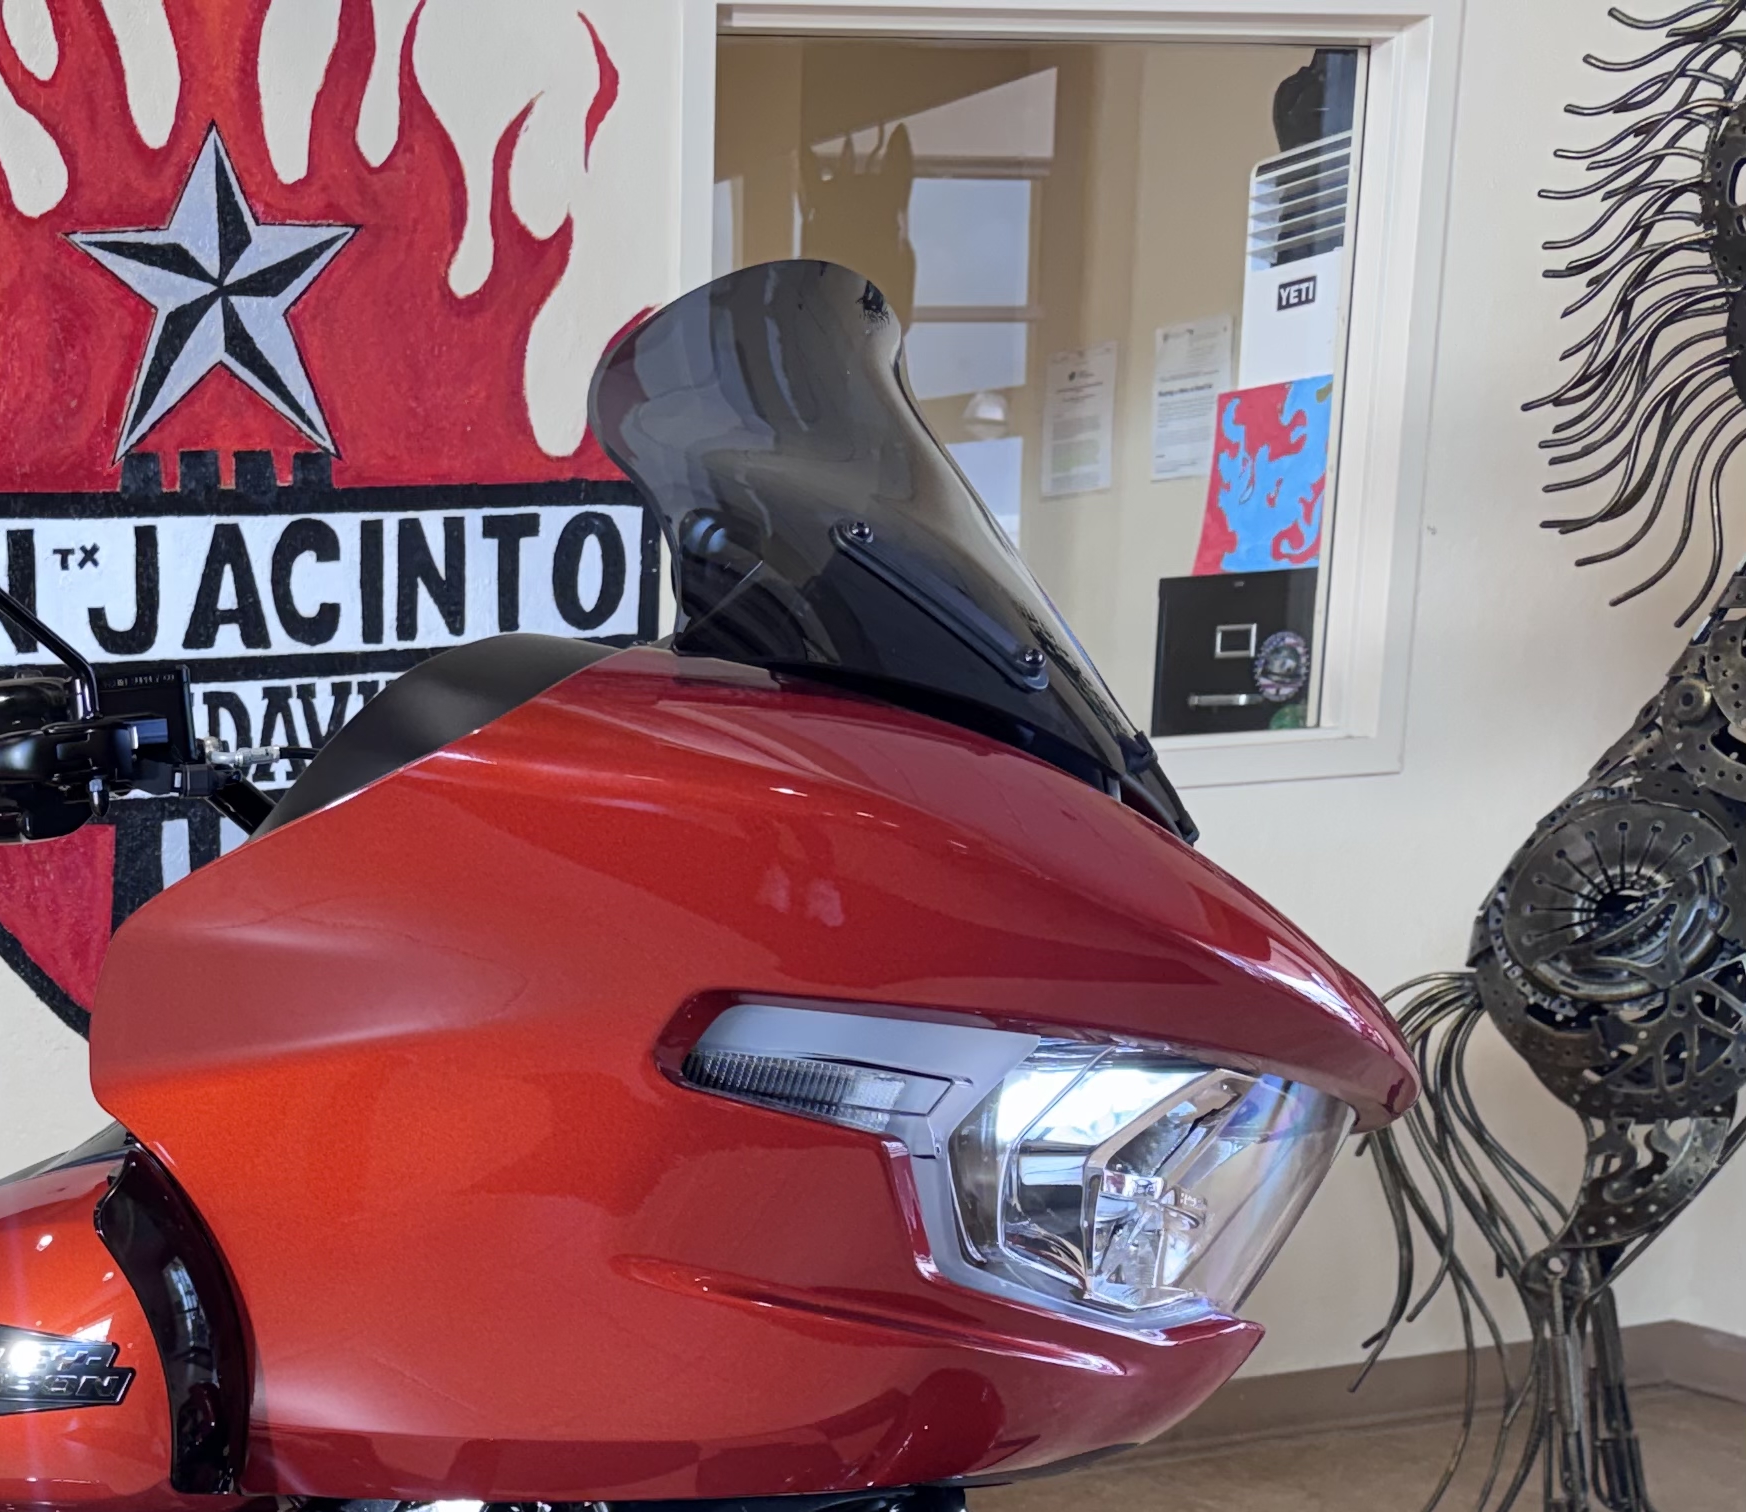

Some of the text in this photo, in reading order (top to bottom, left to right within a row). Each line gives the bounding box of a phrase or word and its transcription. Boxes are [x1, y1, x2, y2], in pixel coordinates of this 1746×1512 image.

[1279, 280, 1315, 306] YETI
[52, 544, 100, 571] TX
[87, 510, 627, 655] JACINTO
